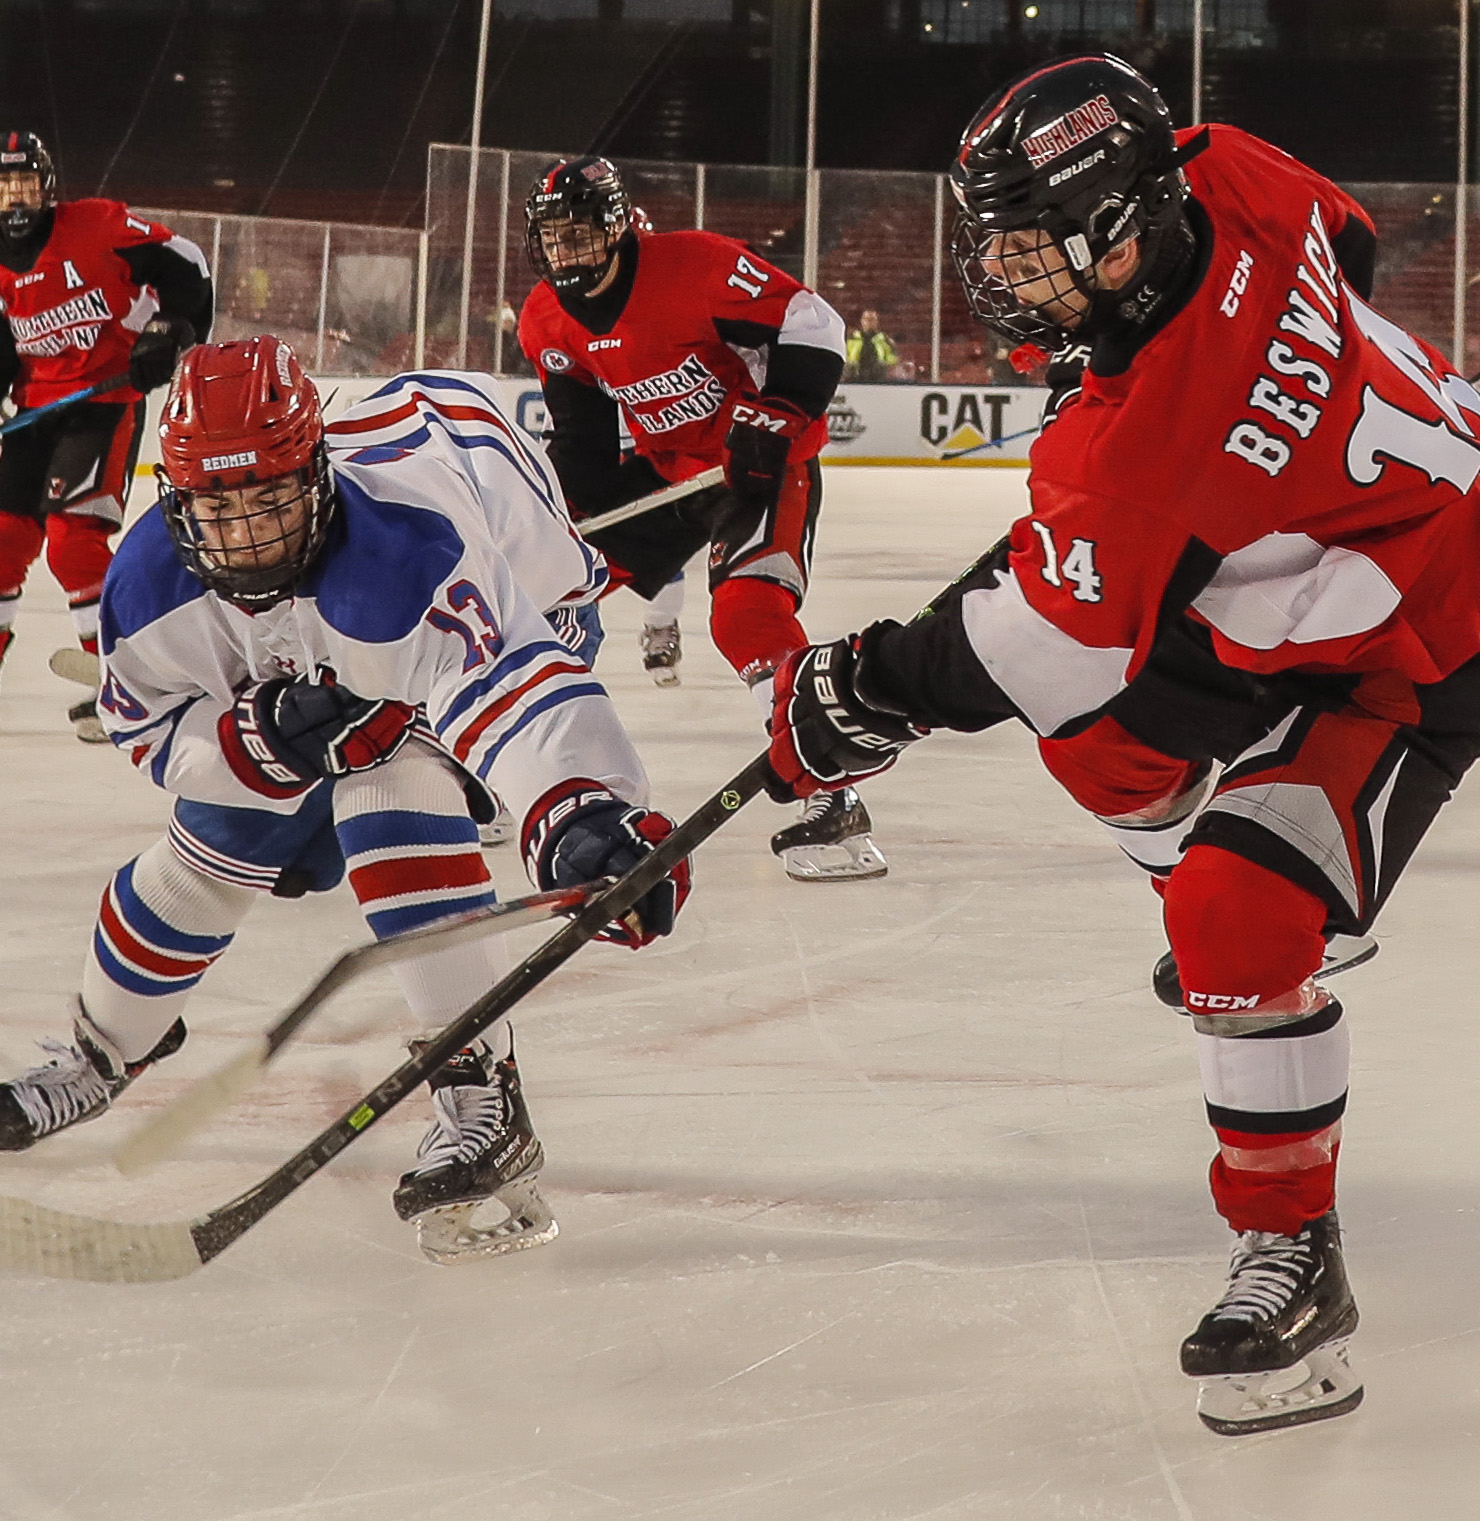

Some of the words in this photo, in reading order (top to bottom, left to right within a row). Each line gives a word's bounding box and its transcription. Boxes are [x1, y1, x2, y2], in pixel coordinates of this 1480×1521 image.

[1021, 94, 1119, 170] HIGHLANDS
[63, 260, 84, 290] A
[727, 255, 770, 300] 17
[1220, 249, 1254, 319] CCM
[587, 338, 621, 352] CCM
[731, 403, 788, 433] CM
[921, 393, 1010, 448] CAT
[201, 450, 258, 473] REDMEN
[1031, 519, 1103, 603] 14
[424, 578, 505, 676] 13
[236, 683, 301, 784] BAU
[523, 790, 615, 890] UER
[1189, 990, 1261, 1011] CCM
